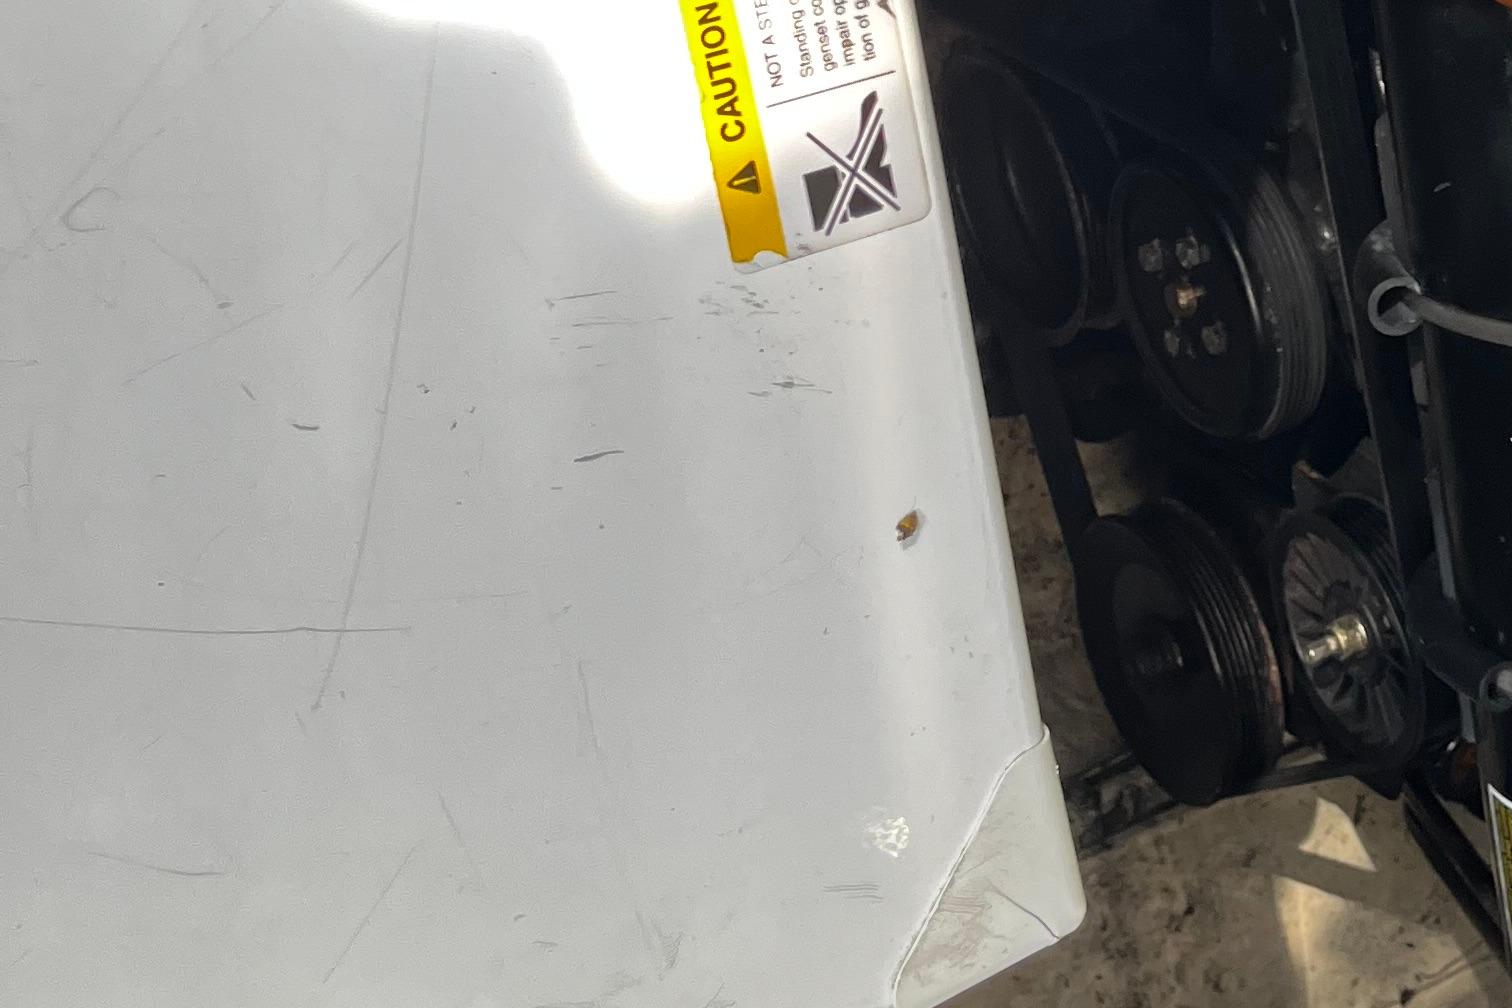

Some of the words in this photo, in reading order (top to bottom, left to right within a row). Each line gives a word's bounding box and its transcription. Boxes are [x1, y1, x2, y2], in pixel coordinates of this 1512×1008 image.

[762, 34, 776, 45] A
[854, 14, 870, 29] of
[792, 9, 814, 78] Standing
[814, 20, 838, 72] genset
[836, 20, 855, 66] impair
[861, 33, 876, 61] tion
[695, 2, 746, 142] CAUTION
[764, 53, 783, 88] NOT
